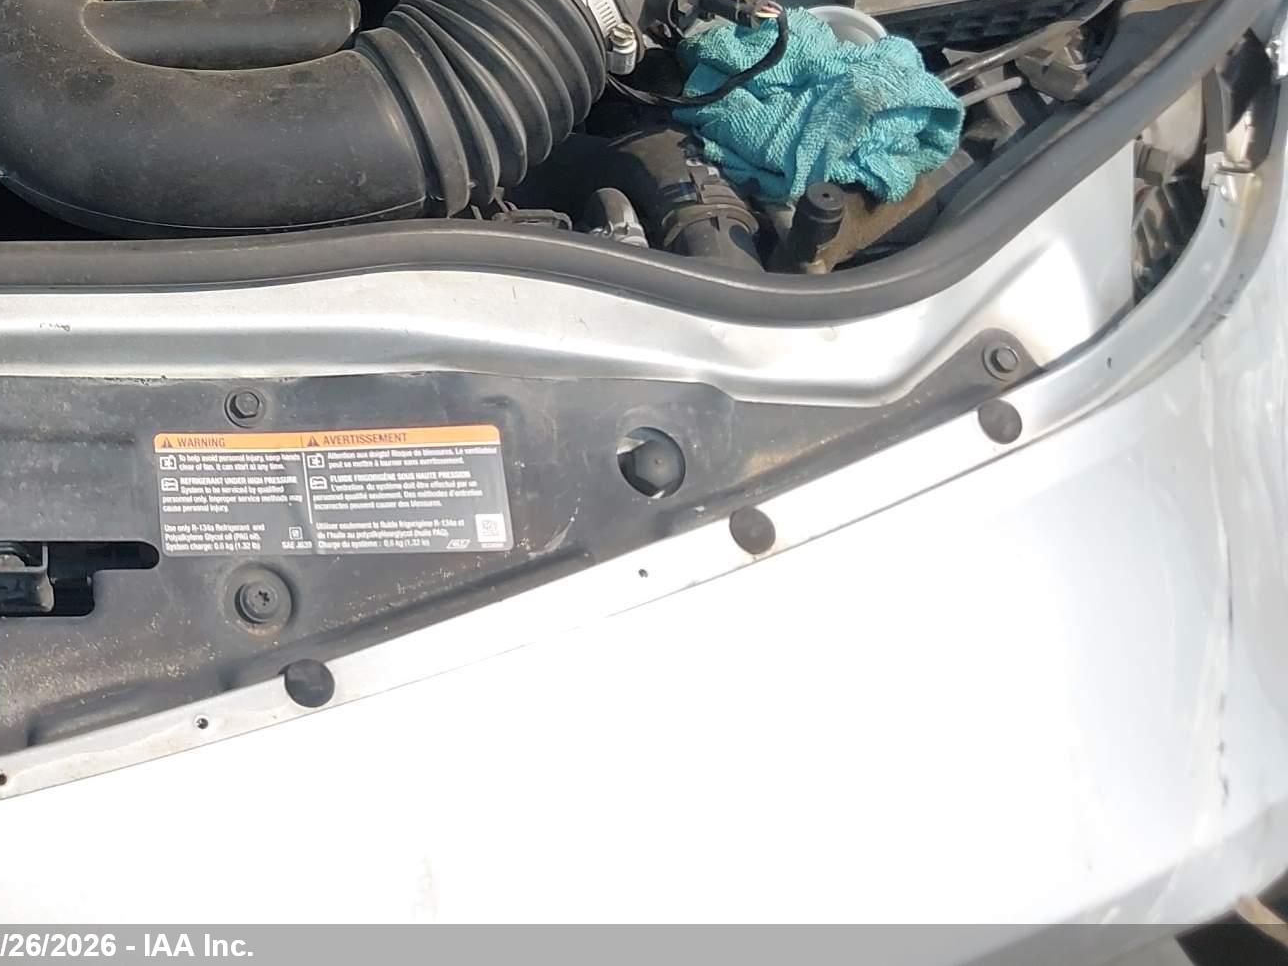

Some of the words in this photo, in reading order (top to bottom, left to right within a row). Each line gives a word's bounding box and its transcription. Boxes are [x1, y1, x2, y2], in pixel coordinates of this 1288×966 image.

[177, 436, 226, 448] WARNING
[323, 432, 406, 446] AVERTISSEMENT
[180, 476, 223, 485] REFRIGERANT
[224, 476, 246, 484] UNDER
[264, 476, 298, 484] PRESSURE
[330, 474, 354, 483] FLUIDE
[396, 472, 416, 480] SOUS
[416, 472, 438, 480] HAUTE
[438, 470, 471, 480] PRESSION
[182, 504, 209, 513] personal
[210, 504, 229, 513] injury.
[176, 524, 191, 532] only
[192, 524, 214, 532] R-134a
[215, 524, 250, 533] Refrigerant
[166, 534, 204, 542] Polyalkylene
[204, 533, 224, 542] Glycol
[224, 533, 232, 541] oil
[233, 532, 248, 542] (PAG
[282, 541, 294, 549] SAE
